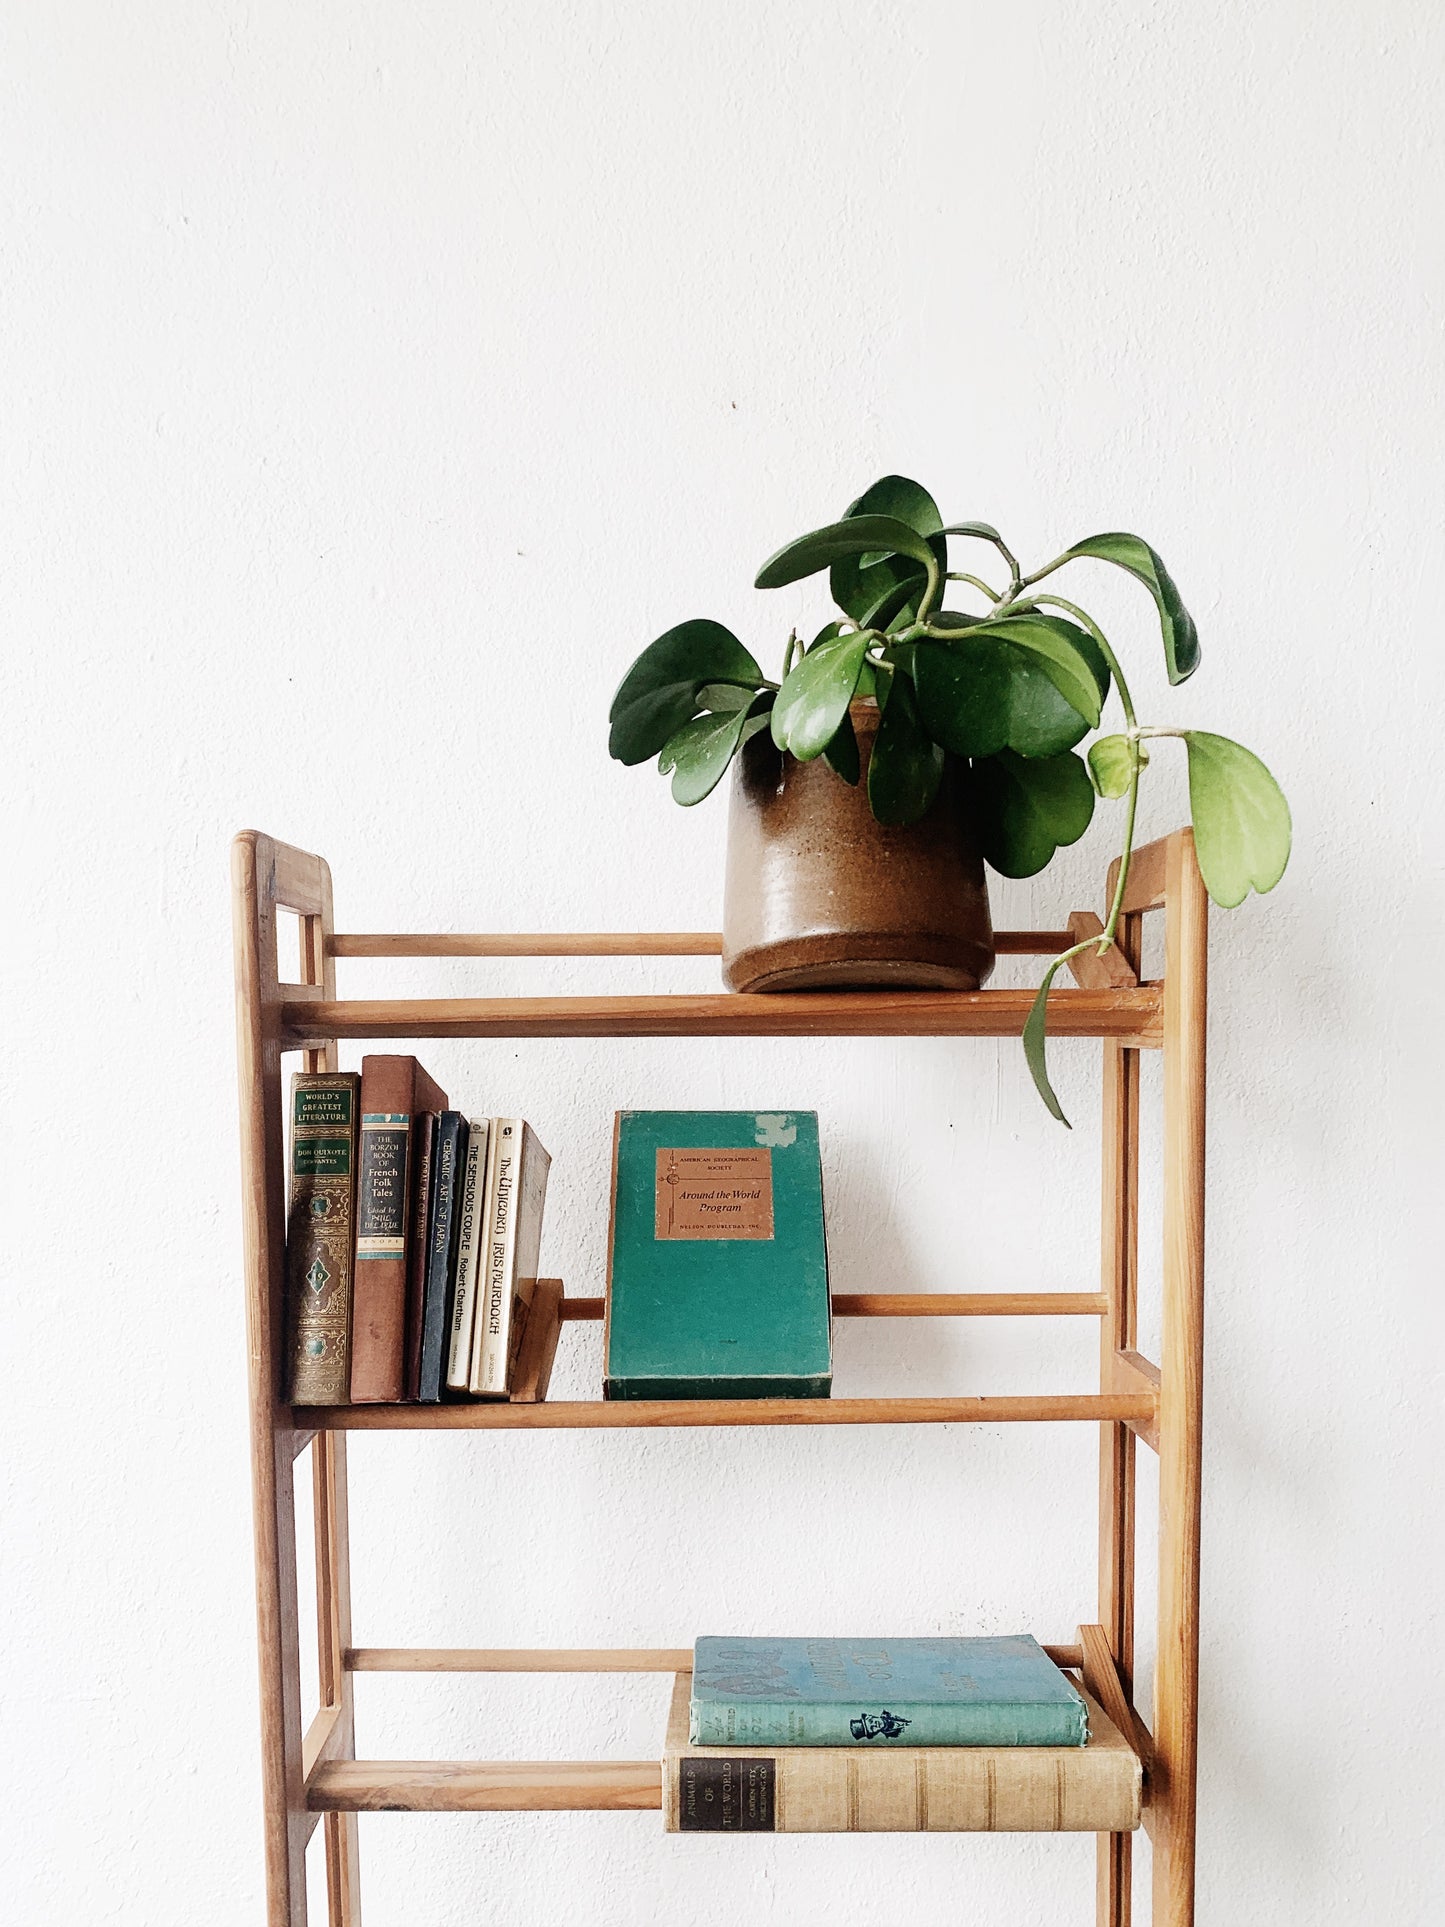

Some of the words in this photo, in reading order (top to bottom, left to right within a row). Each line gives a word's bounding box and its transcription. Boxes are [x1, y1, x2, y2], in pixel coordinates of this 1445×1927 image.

[442, 1138, 452, 1179] CERAMIC
[470, 1145, 478, 1162] THE
[369, 1168, 398, 1176] French
[500, 1157, 511, 1176] The
[372, 1189, 393, 1197] Tales
[440, 1184, 449, 1203] ART
[465, 1164, 477, 1212] SENSUOUS
[680, 1191, 715, 1200] Around
[732, 1190, 760, 1199] World
[438, 1205, 446, 1220] OF
[700, 1204, 741, 1213] Program
[435, 1222, 445, 1253] JAPAN
[461, 1215, 473, 1250] COUPLE
[493, 1242, 504, 1268] IRIS
[458, 1258, 468, 1286] Robert
[454, 1288, 466, 1331] Chartham
[723, 1763, 732, 1802] WORLD
[687, 1770, 696, 1816] ANIMALS
[705, 1787, 714, 1802] OF
[723, 1806, 732, 1825] THE
